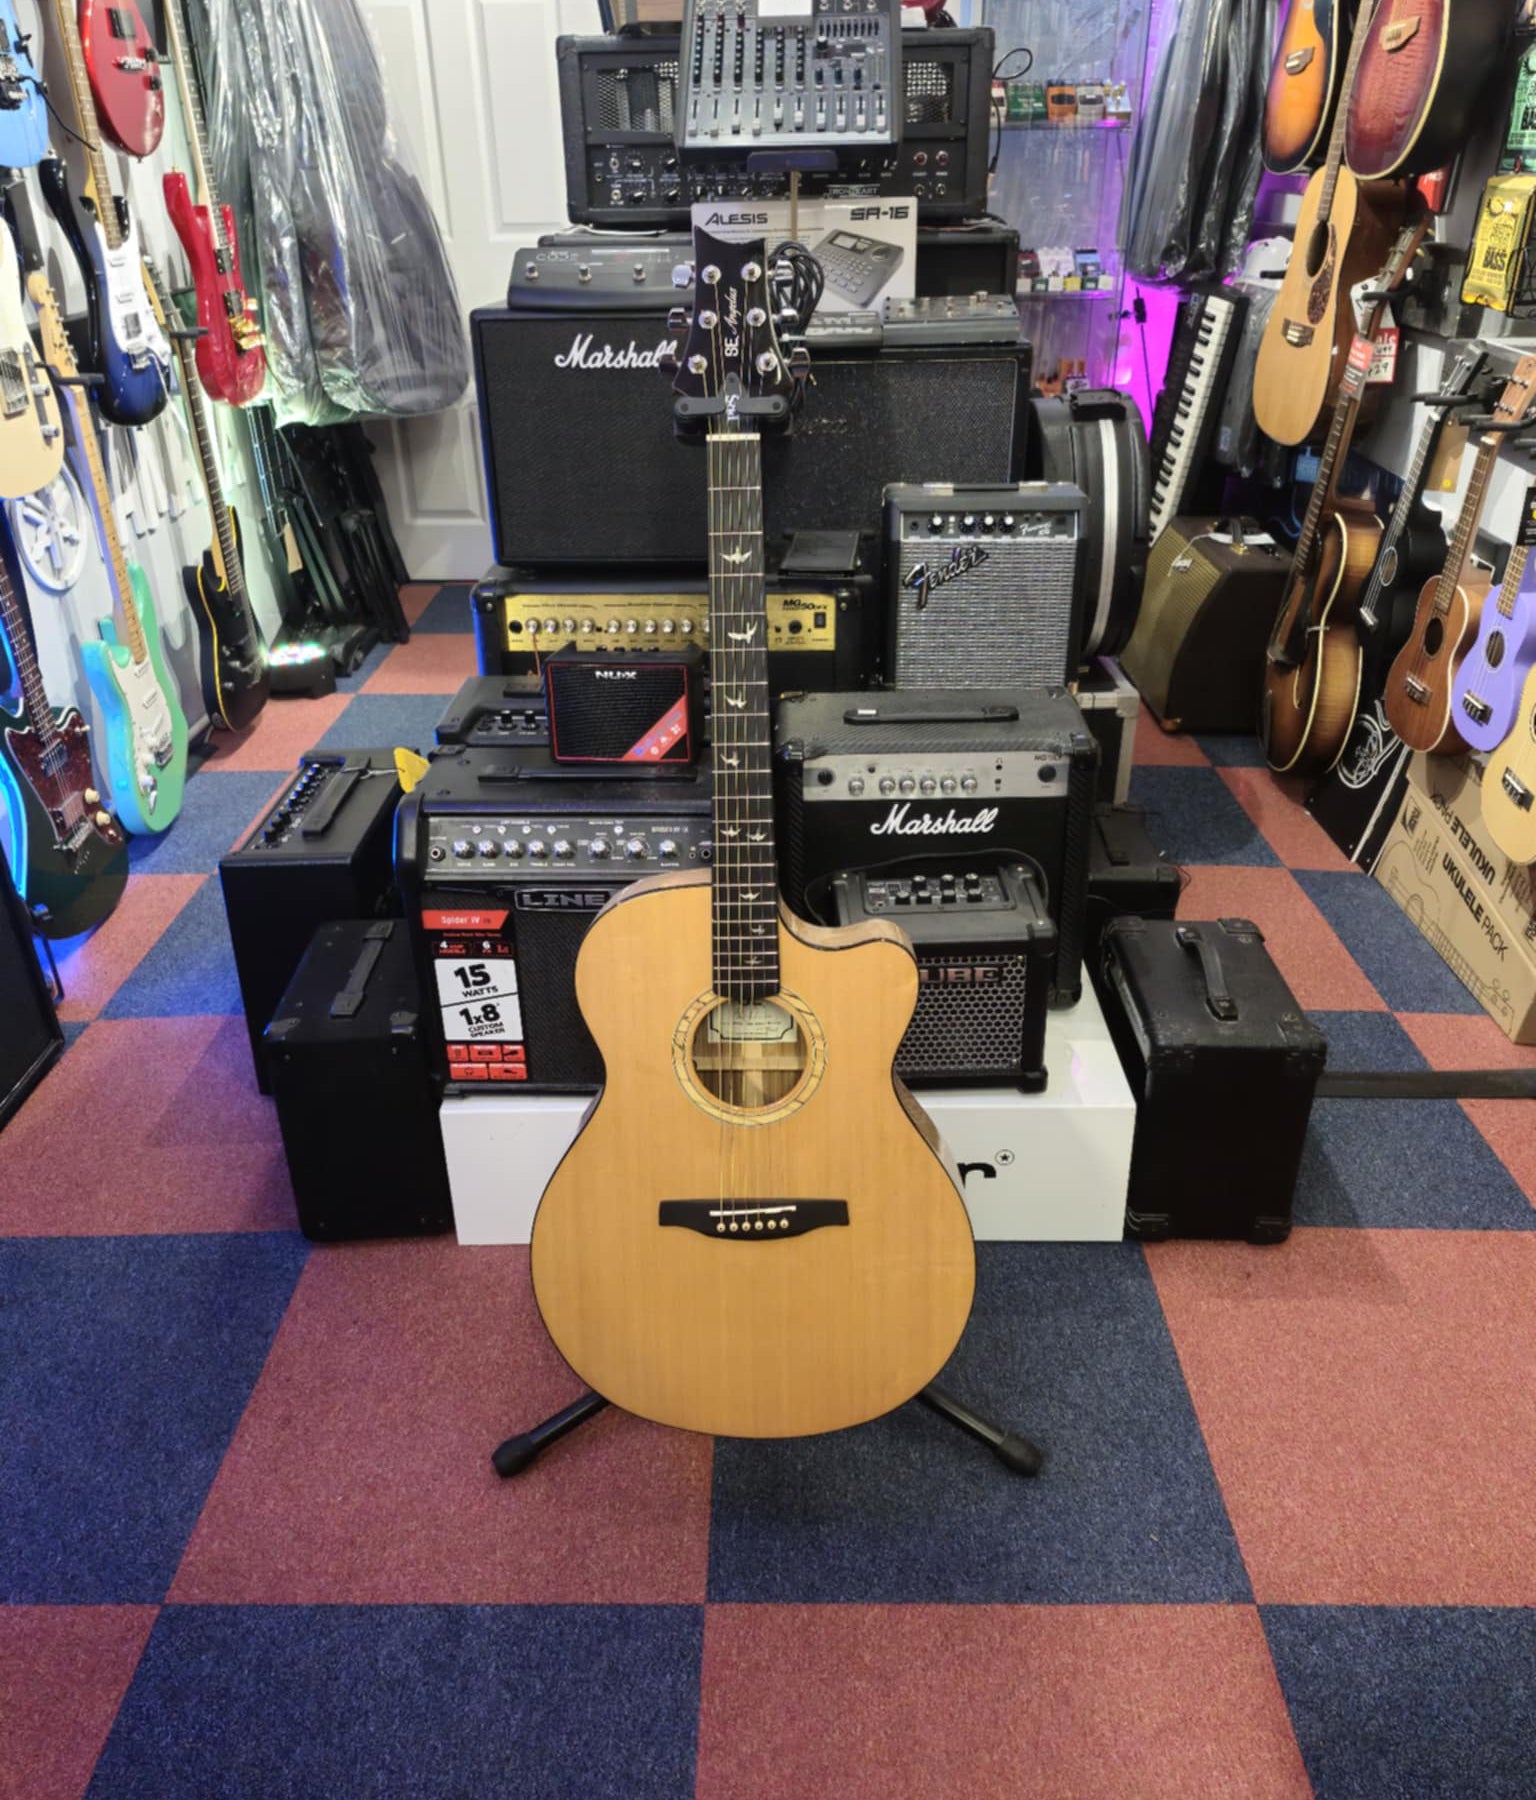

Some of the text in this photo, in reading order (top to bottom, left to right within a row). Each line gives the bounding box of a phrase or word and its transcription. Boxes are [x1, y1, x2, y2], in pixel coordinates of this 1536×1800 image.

[705, 213, 769, 226] ALESIS
[851, 206, 909, 221] SR-16
[724, 338, 739, 357] SE
[902, 545, 990, 610] Fender
[869, 802, 1000, 835] Marshall
[1450, 815, 1496, 886] UKULELE
[522, 894, 605, 906] LINE
[1442, 851, 1510, 963] UKULELE PACK
[441, 916, 469, 925] Spider
[454, 963, 491, 989] 15
[920, 966, 1001, 982] UBE
[462, 985, 499, 999] WATTS
[468, 1022, 504, 1034] CUSTOM
[470, 1028, 506, 1039] SPEAKER
